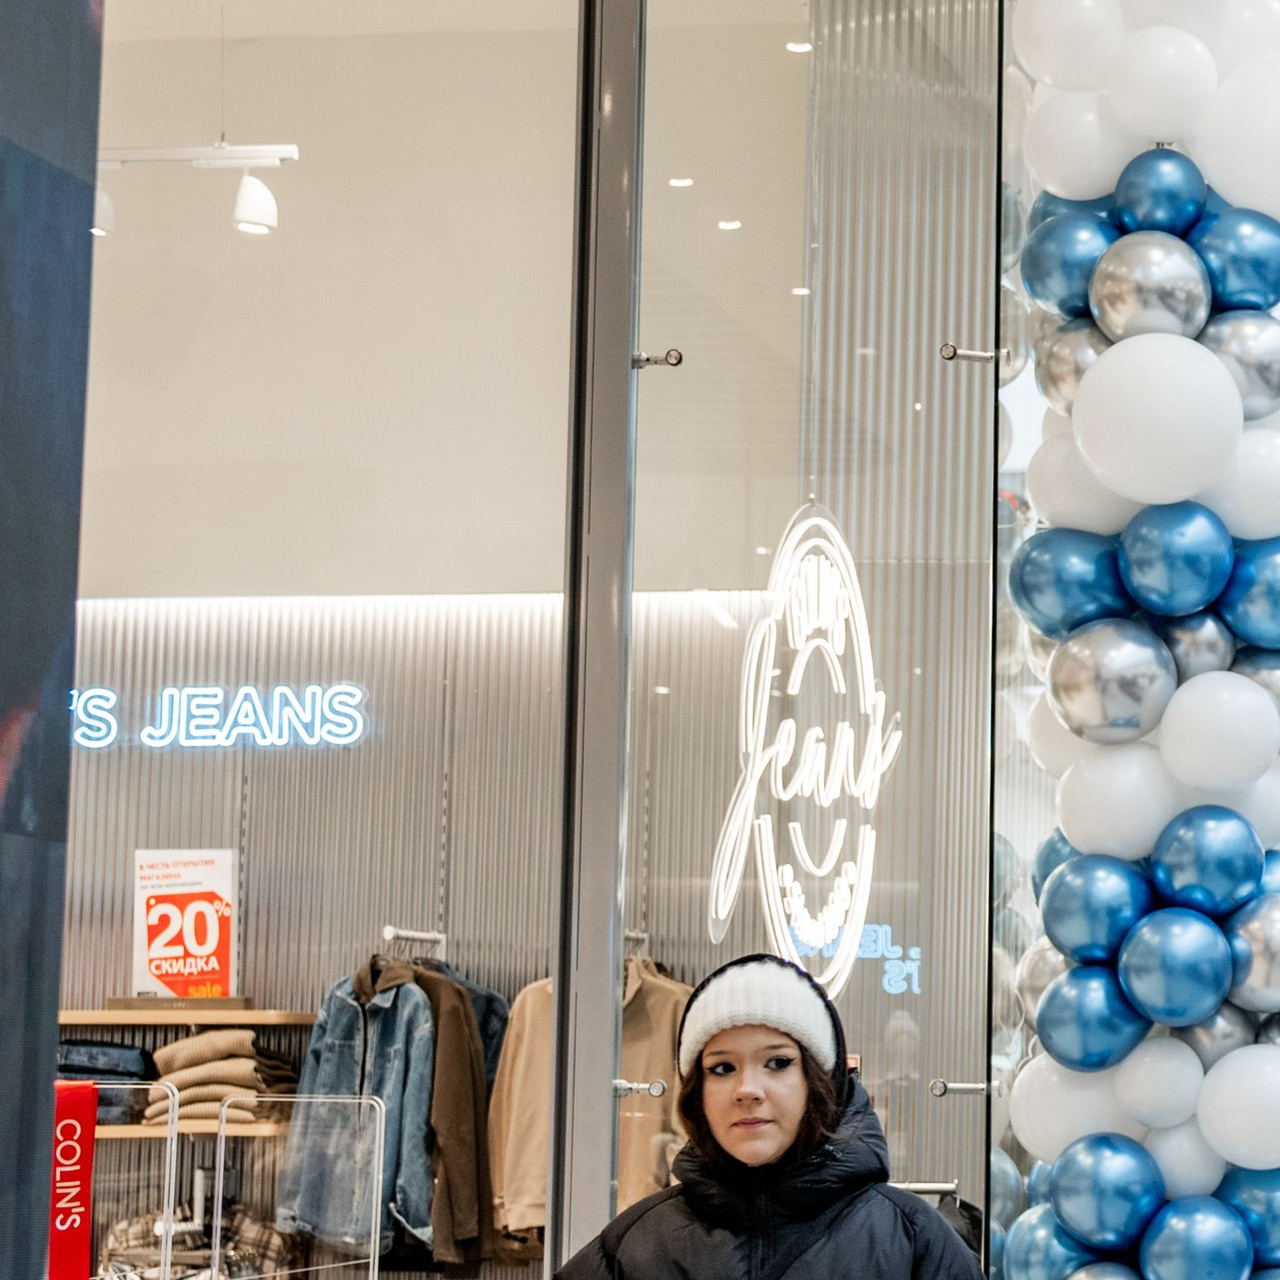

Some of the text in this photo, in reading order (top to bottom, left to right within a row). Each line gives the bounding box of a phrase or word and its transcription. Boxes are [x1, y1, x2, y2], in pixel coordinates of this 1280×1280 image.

[140, 684, 364, 748] JEANS
[150, 956, 220, 976] СКИДКА
[55, 1119, 86, 1232] COLIN'S
